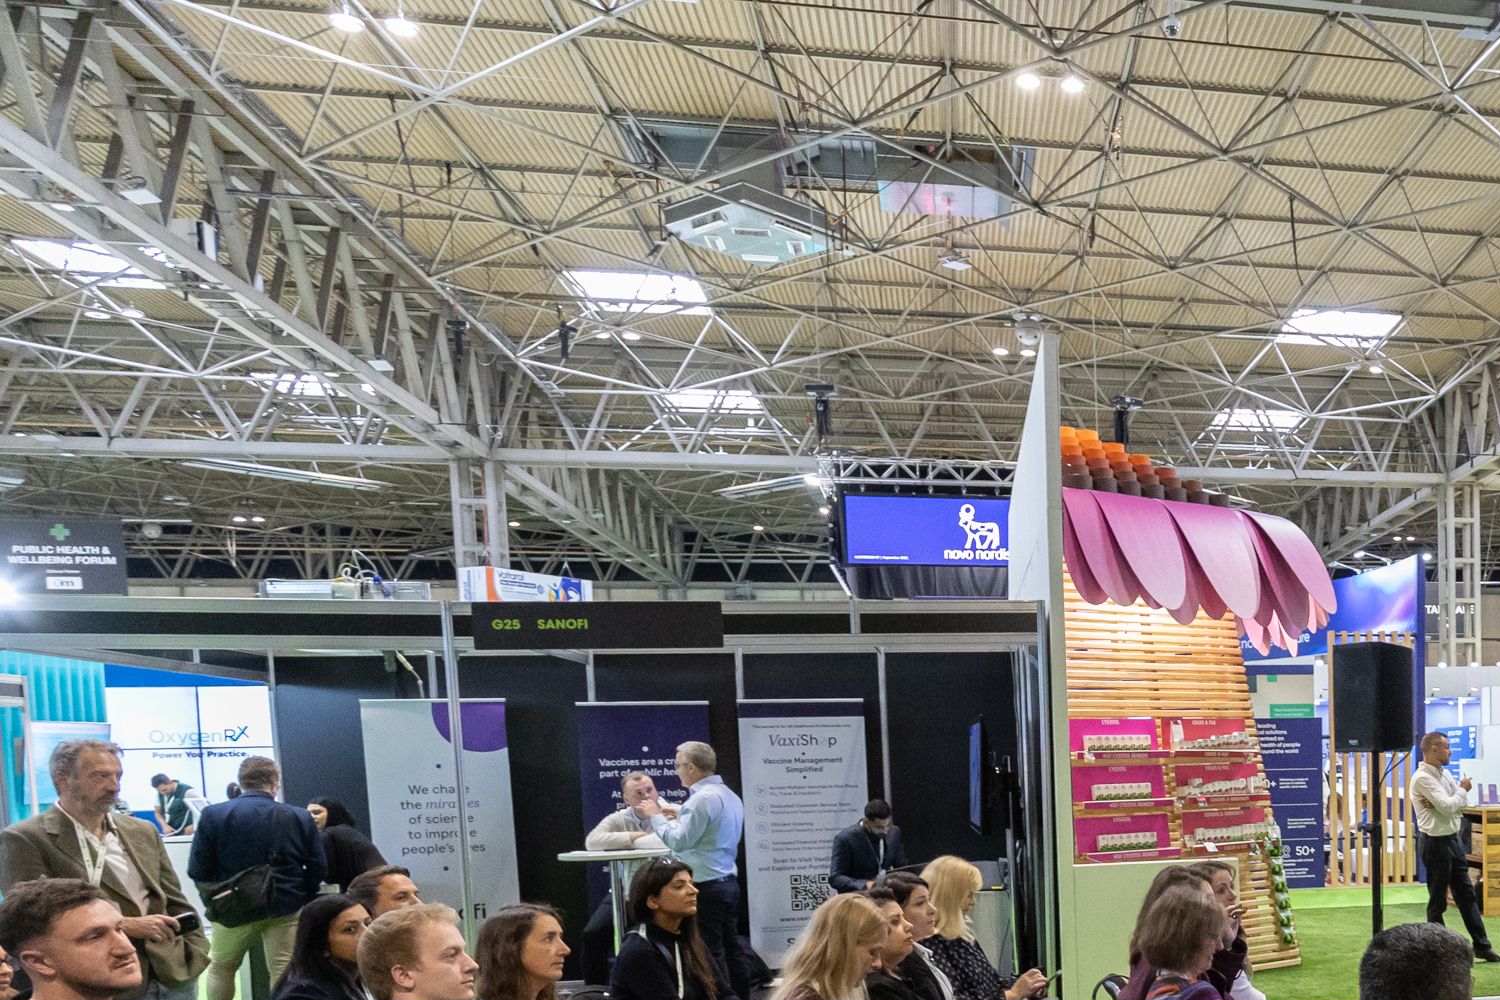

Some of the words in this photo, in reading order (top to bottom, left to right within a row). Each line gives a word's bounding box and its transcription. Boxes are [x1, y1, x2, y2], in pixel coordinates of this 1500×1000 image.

[11, 545, 55, 554] PUBLIC
[55, 545, 100, 555] HEALTH
[101, 546, 111, 555] &
[943, 549, 972, 560] novo
[7, 555, 73, 565] WELLBEING
[75, 556, 117, 565] FORUM
[491, 618, 521, 630] G25
[537, 618, 589, 630] SANOFI
[152, 751, 182, 759] Power
[598, 758, 640, 767] Vaccines
[762, 757, 792, 765] Vaccine
[794, 757, 843, 766] Management
[600, 769, 619, 779] part
[785, 766, 823, 774] Simplified
[408, 784, 429, 795] We
[667, 789, 687, 799] help
[400, 800, 422, 810] the
[426, 799, 480, 809] miraes
[408, 814, 422, 825] of
[408, 830, 422, 840] to
[401, 843, 455, 857] people's
[1295, 846, 1316, 856] 50+
